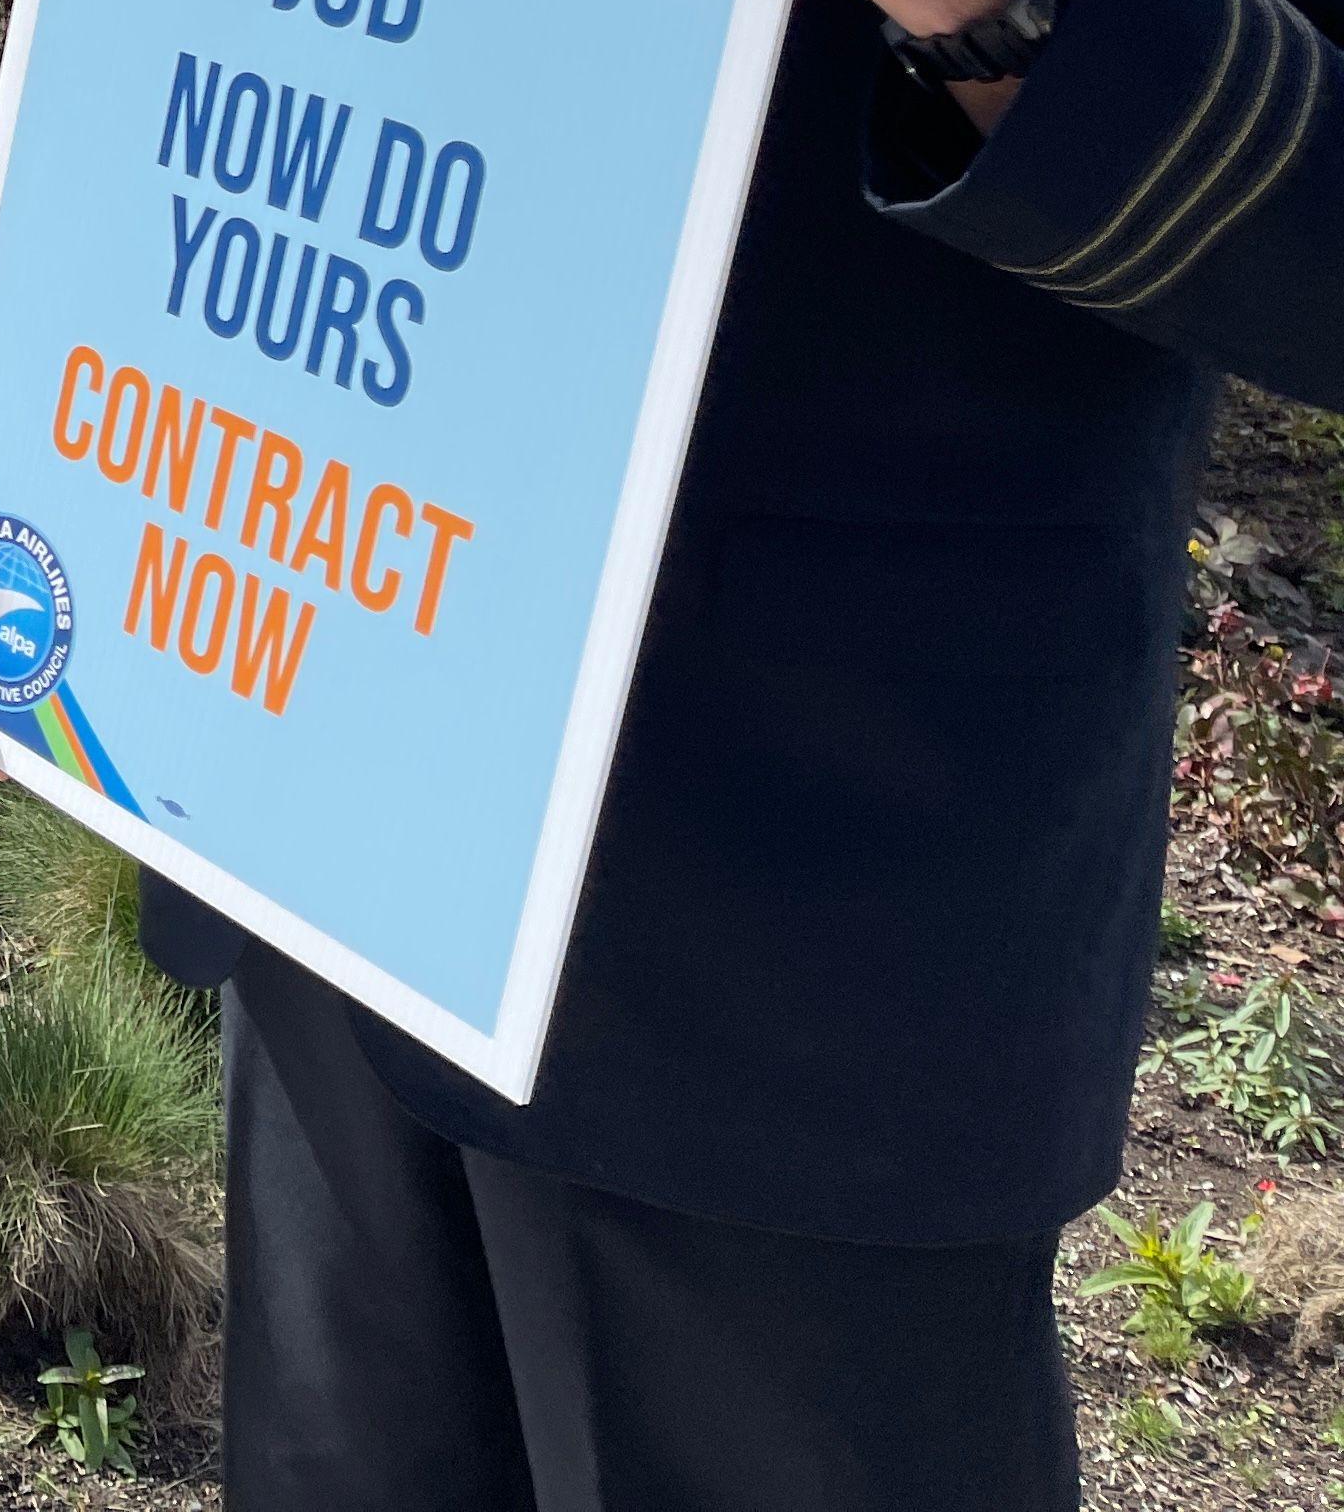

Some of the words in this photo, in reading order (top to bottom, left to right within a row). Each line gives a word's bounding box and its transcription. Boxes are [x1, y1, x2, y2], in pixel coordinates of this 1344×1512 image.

[156, 50, 355, 223] NOW
[358, 117, 487, 273] DO
[164, 192, 427, 409] YOURS
[15, 527, 72, 631] AIRLINES
[51, 344, 476, 639] CONTRACT
[23, 643, 69, 700] COUNCIL
[122, 521, 318, 719] NOW
